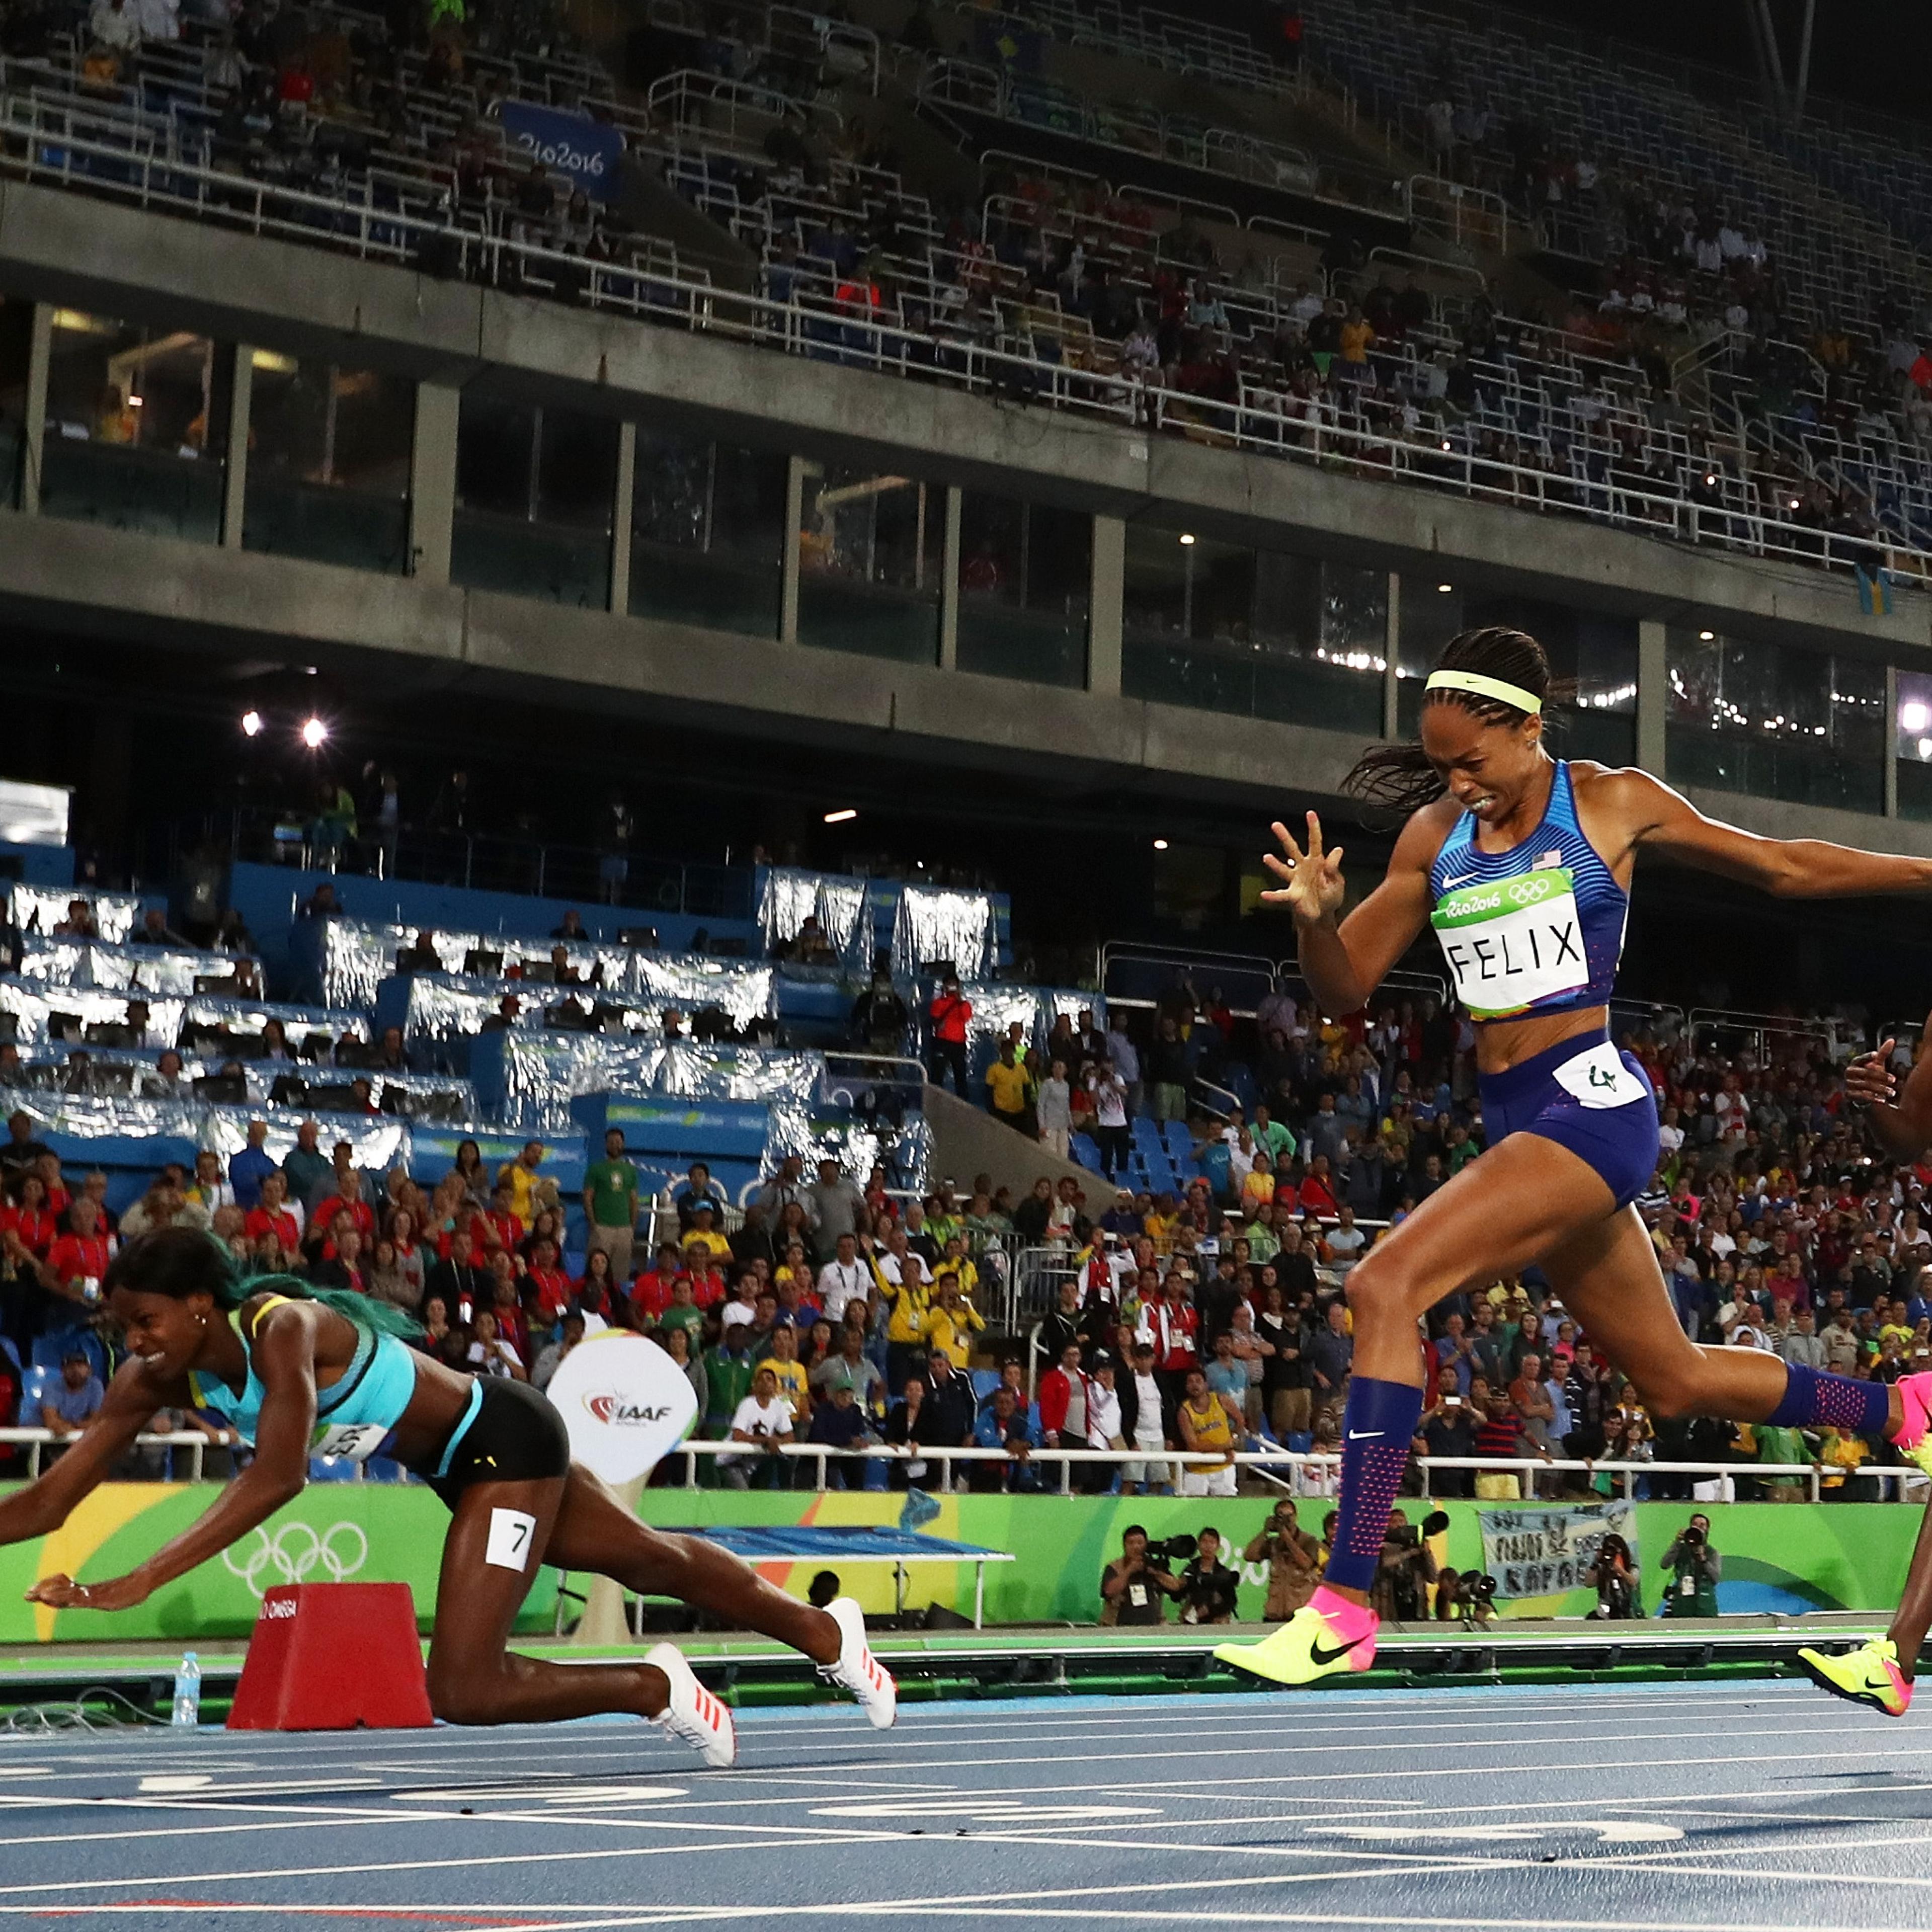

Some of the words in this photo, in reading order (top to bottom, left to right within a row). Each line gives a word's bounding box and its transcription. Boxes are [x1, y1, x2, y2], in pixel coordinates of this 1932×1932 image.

[1445, 892, 1501, 918] Rio2016
[1447, 922, 1580, 985] FELIX
[1589, 1065, 1617, 1092] 4
[617, 1405, 672, 1421] IAAF
[513, 1523, 527, 1553] 7
